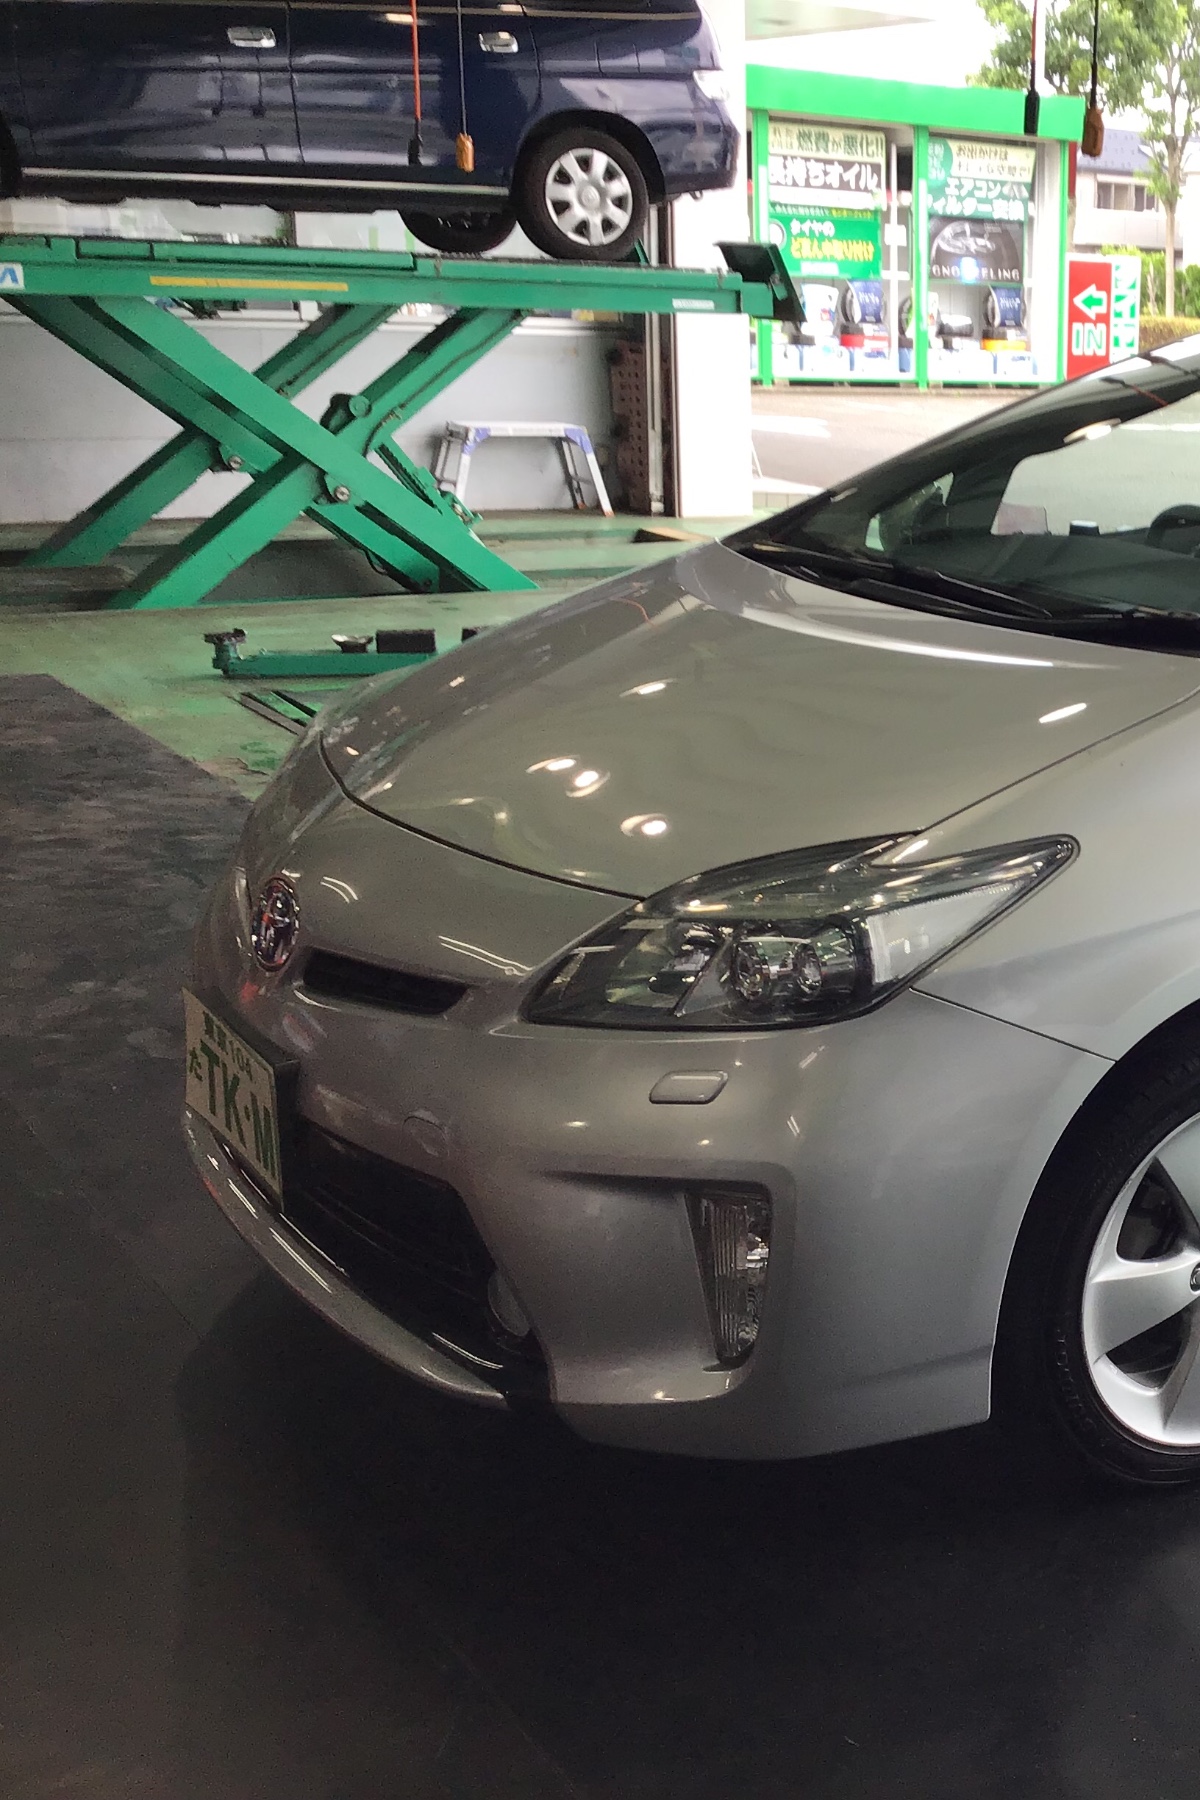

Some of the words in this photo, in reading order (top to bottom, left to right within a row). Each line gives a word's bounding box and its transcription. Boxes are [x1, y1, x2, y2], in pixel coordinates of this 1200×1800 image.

[945, 177, 1002, 199] エアコン
[1071, 322, 1107, 356] IN
